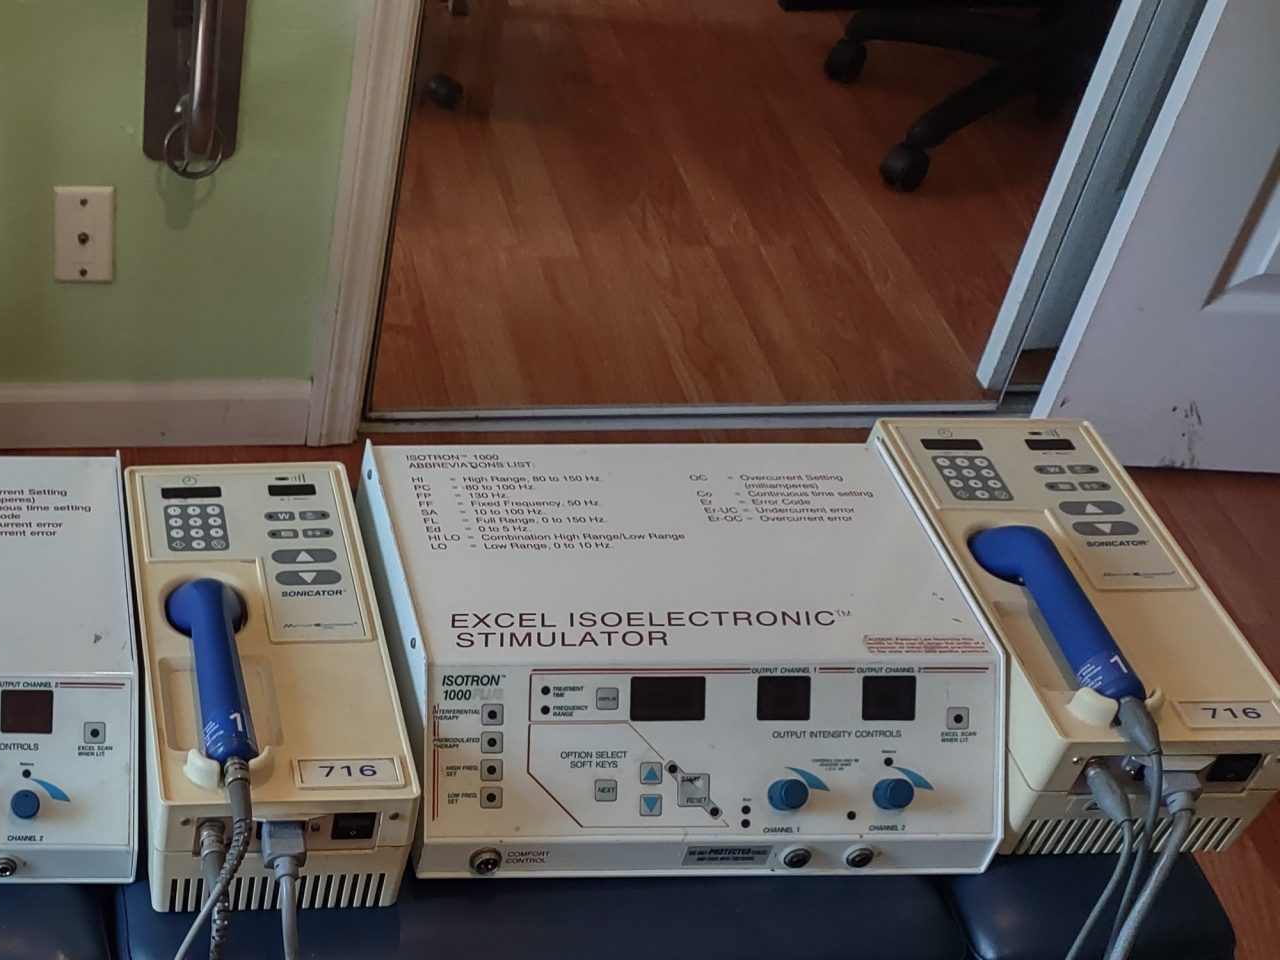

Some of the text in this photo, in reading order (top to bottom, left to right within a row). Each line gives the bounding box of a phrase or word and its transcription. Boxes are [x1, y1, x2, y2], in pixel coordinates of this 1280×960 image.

[28, 488, 67, 497] Setting
[53, 504, 91, 512] setting
[451, 612, 557, 629] EXCEL
[455, 630, 669, 648] STIMULATOR
[1110, 655, 1128, 673] 1
[443, 689, 472, 701] 1000
[1201, 707, 1261, 720] 716
[229, 712, 243, 732] 1
[772, 730, 902, 739] OUTPUT INTENSITY CONTROLS
[560, 751, 628, 759] OPTION SELECT
[595, 760, 618, 768] KEYS
[318, 765, 377, 778] 716
